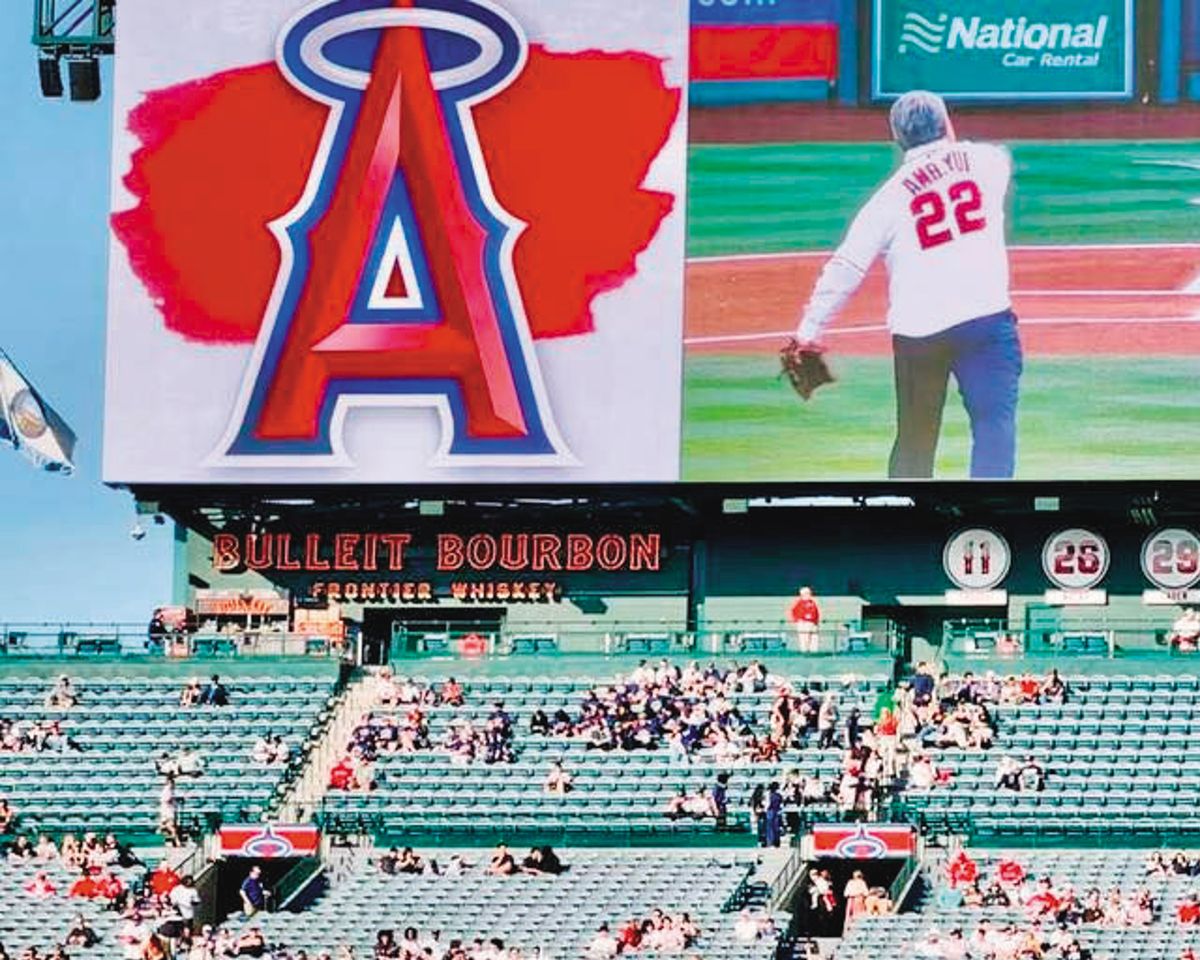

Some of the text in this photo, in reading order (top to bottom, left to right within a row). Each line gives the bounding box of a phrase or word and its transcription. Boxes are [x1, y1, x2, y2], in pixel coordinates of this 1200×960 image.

[947, 15, 1109, 50] National
[1002, 52, 1100, 67] Car Rental
[910, 180, 986, 250] 22
[212, 533, 661, 571] BULLEIT BOURBON
[963, 539, 991, 575] 11
[1054, 540, 1100, 575] 26
[1152, 540, 1198, 575] 29
[311, 581, 558, 600] FRONTIER WHISKEY
